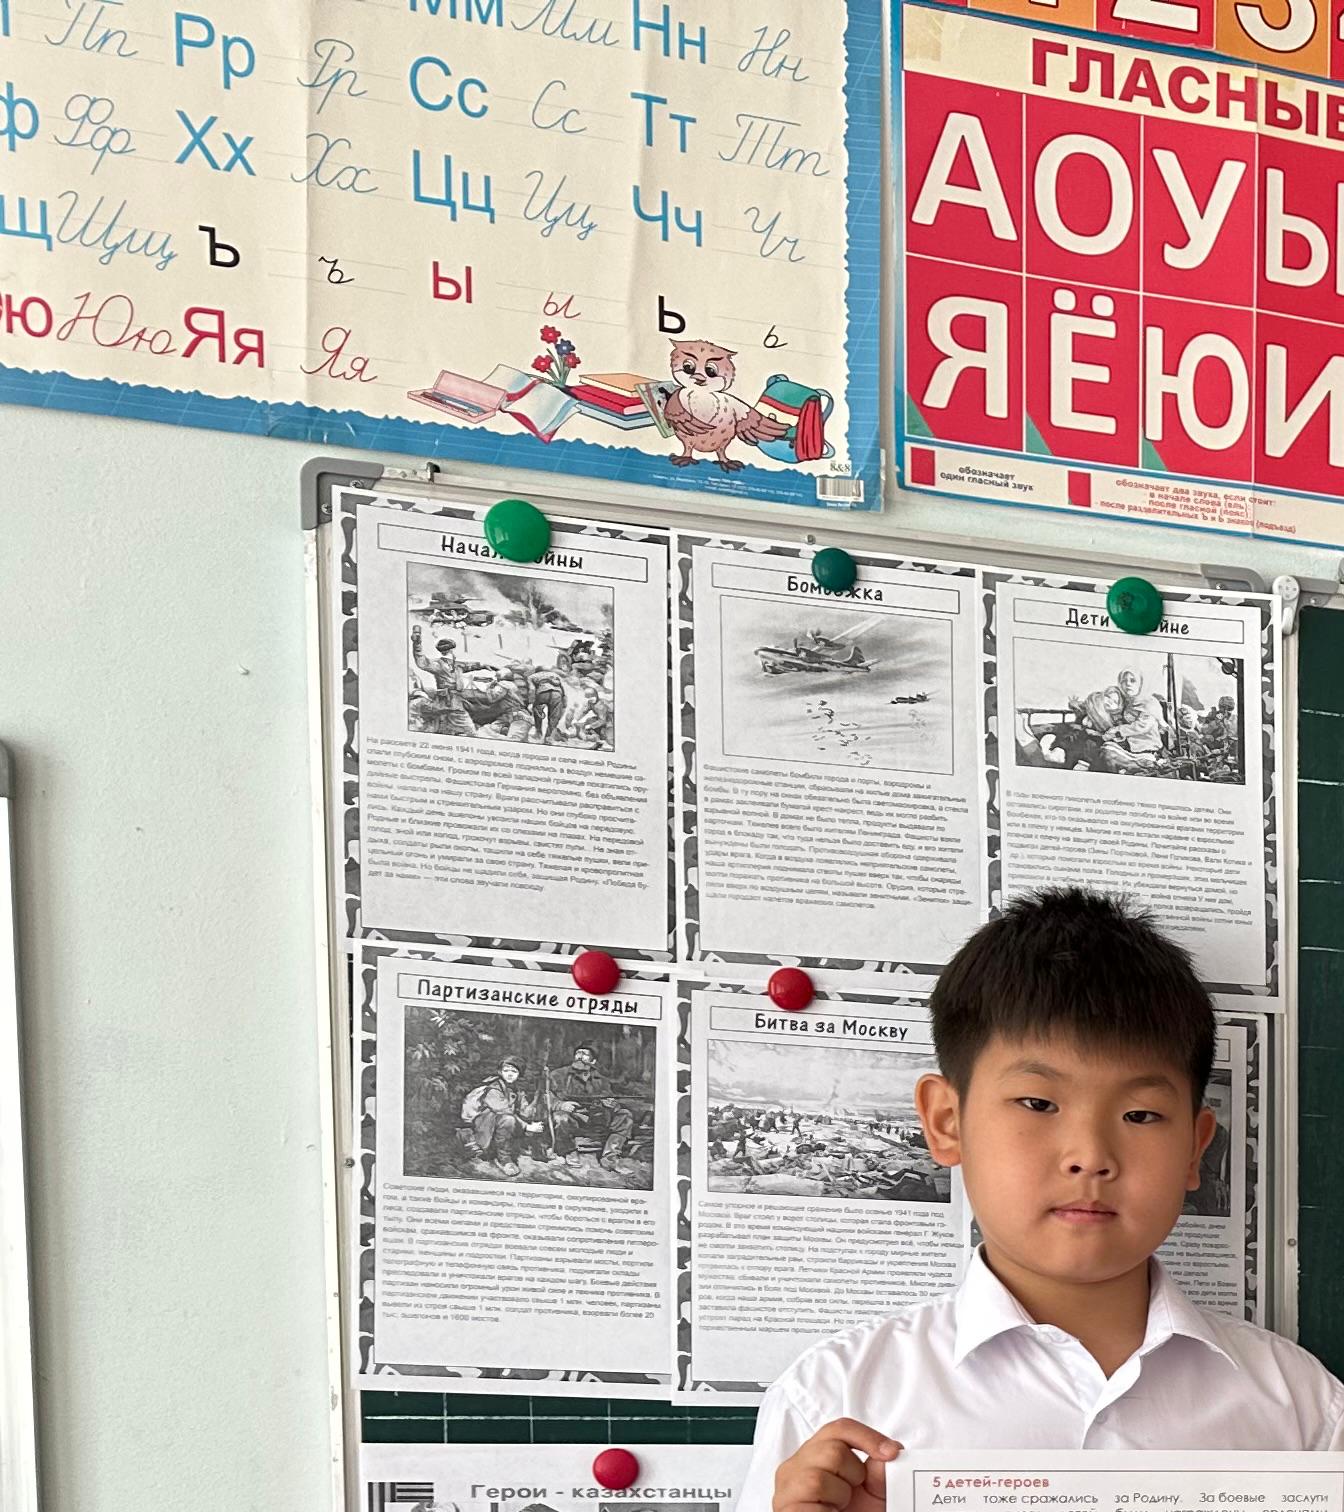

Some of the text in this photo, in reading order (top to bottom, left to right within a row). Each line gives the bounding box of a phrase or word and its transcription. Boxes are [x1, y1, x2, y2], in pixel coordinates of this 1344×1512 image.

[174, 12, 255, 89] Рр
[633, 4, 706, 64] Нн
[410, 56, 488, 118] Сс
[175, 109, 256, 176] Хх
[631, 91, 697, 153] Тт
[412, 149, 495, 224] Цц
[632, 184, 702, 247] Чч
[198, 225, 240, 267] Ъ
[432, 261, 472, 304] Ы
[181, 306, 265, 368] Яя
[1065, 607, 1108, 628] Дети
[417, 979, 639, 1015] Партизанские отряды
[755, 1012, 908, 1041] Битва за Москву
[471, 1484, 732, 1501] Герои казахстанцы
[932, 1494, 966, 1505] Дети
[983, 1495, 1017, 1504] тоже
[1021, 1494, 1098, 1505] сражались
[1114, 1494, 1130, 1504] за
[1199, 1493, 1215, 1503] За
[1218, 1492, 1266, 1503] боевые
[1282, 1493, 1329, 1504] заслуги
[933, 1476, 1050, 1490] 5 детей-героев
